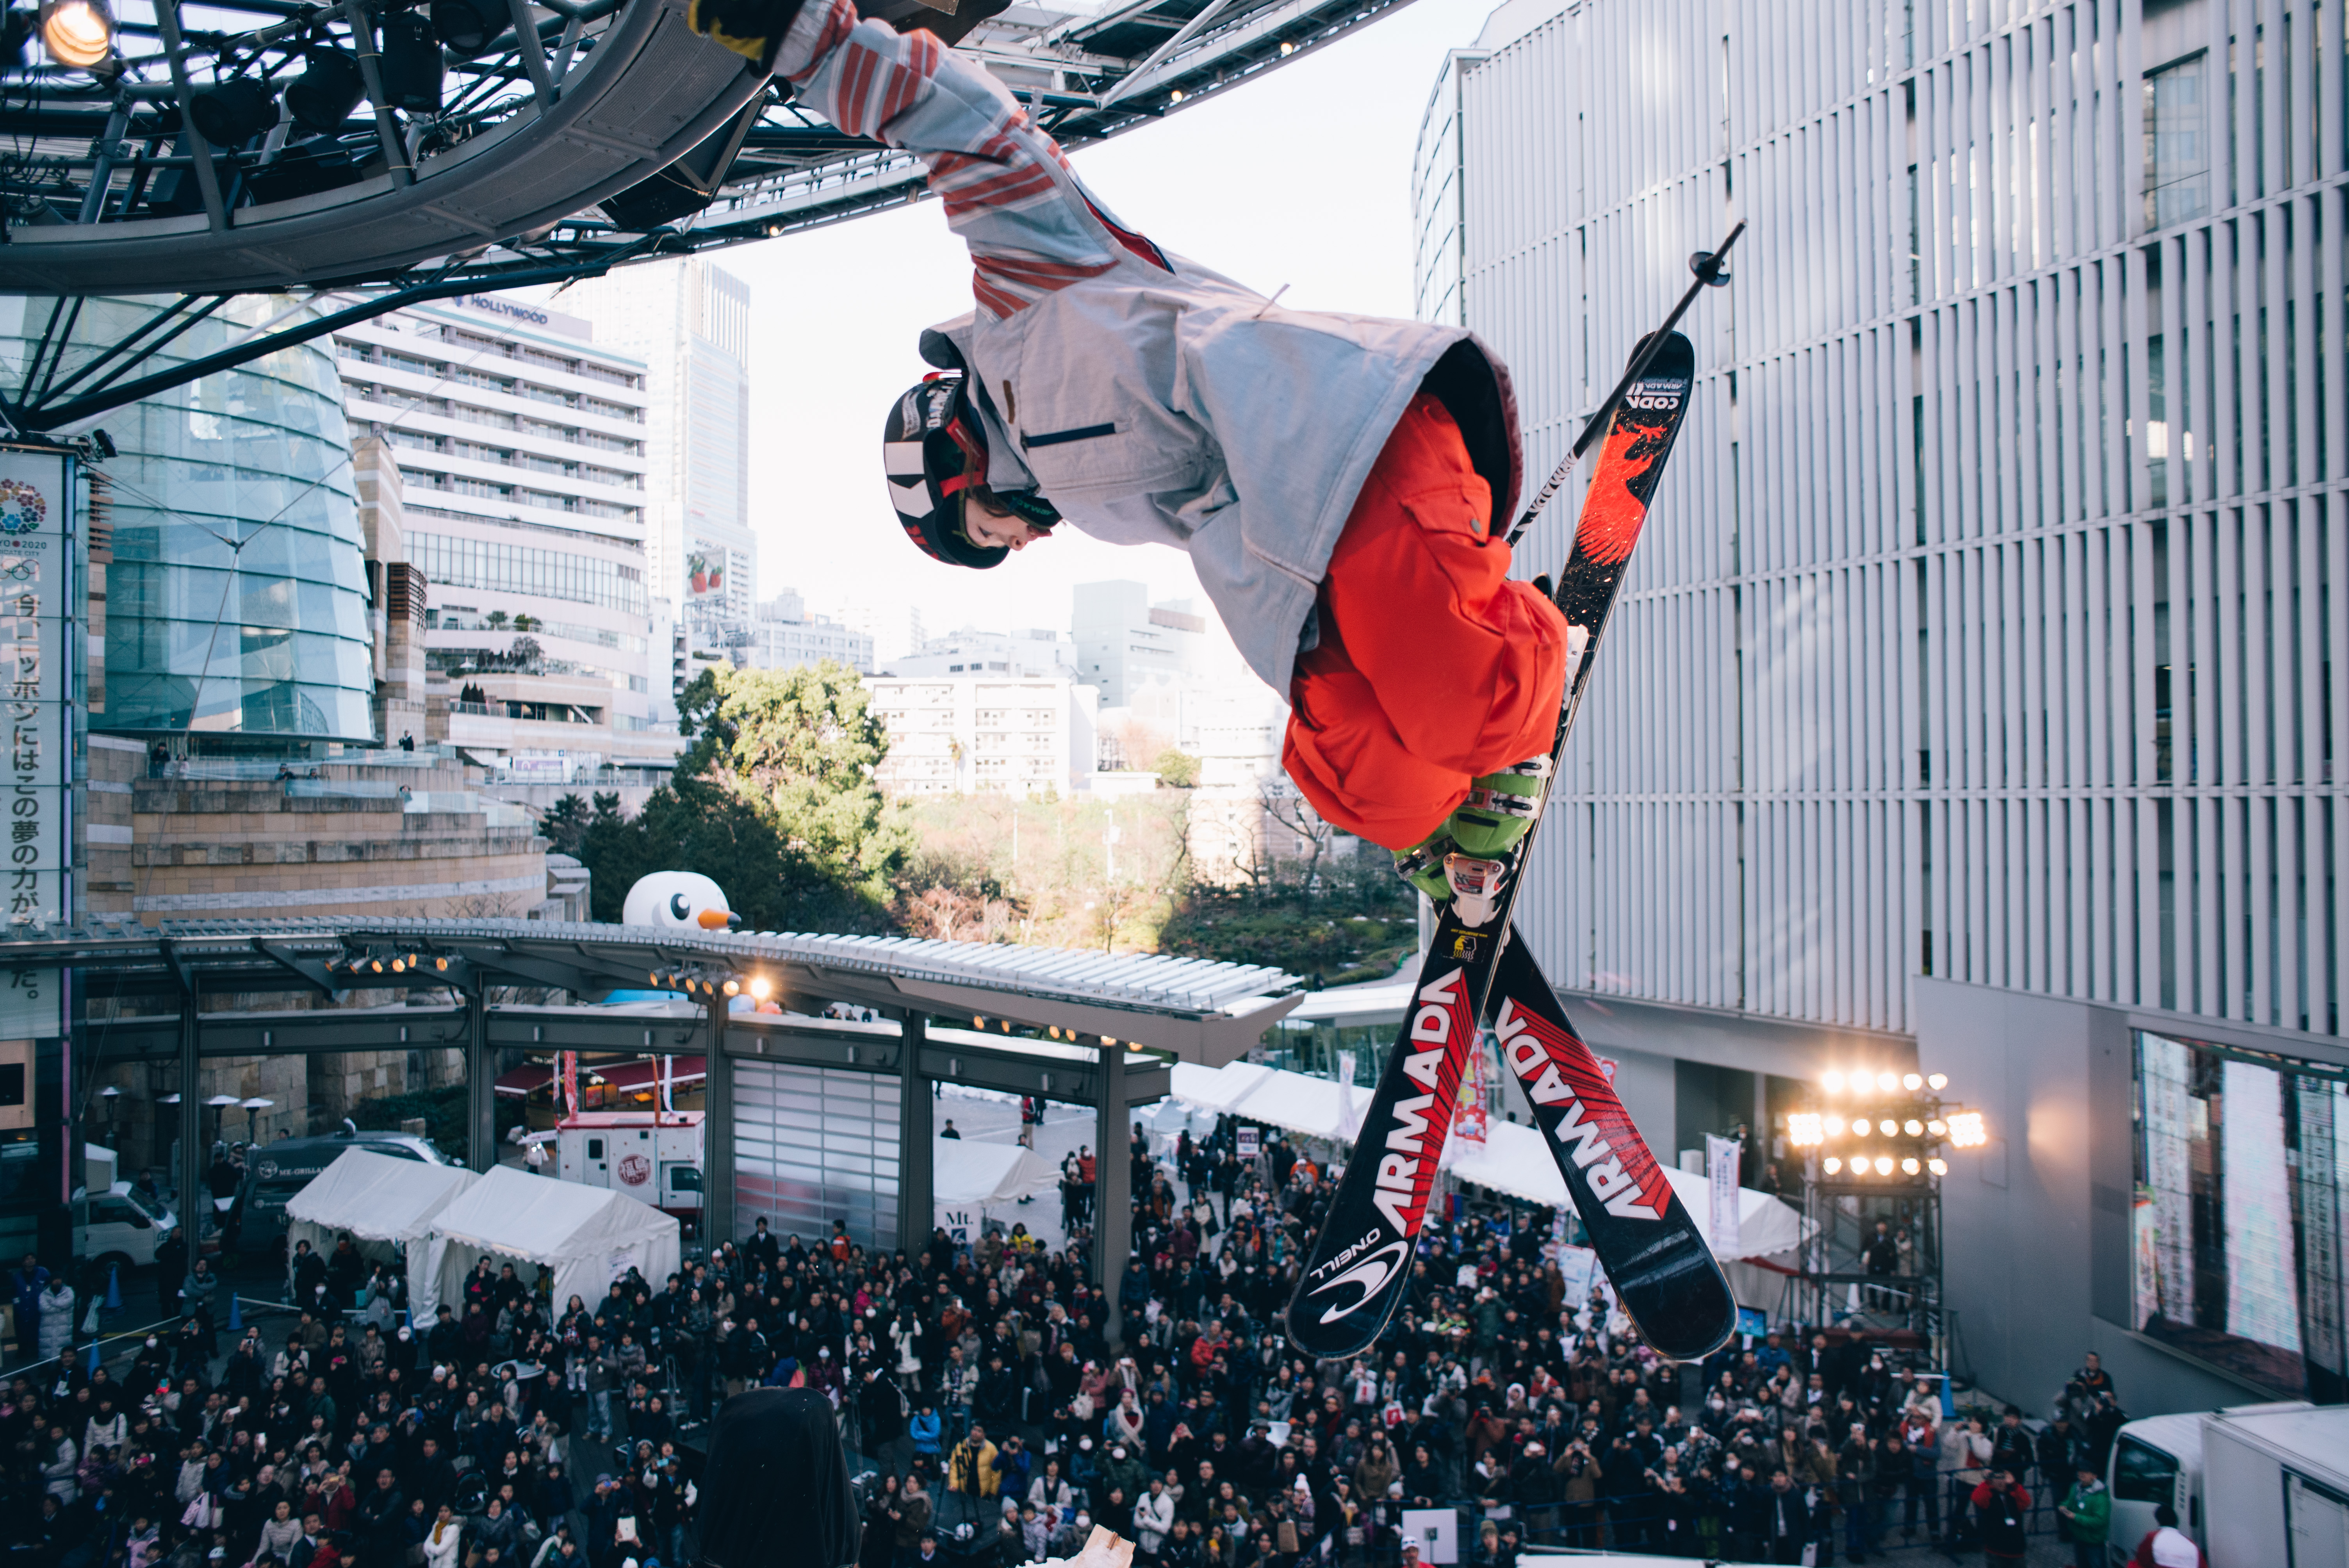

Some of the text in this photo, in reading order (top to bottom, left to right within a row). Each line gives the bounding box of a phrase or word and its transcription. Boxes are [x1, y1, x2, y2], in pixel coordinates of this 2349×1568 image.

[471, 295, 548, 324] HOLLYWOOD
[1625, 396, 1679, 410] CODA
[22, 540, 46, 549] 2020
[1372, 966, 1461, 1238] ARMADA
[1494, 995, 1662, 1220] ARMADA
[946, 1211, 973, 1226] Mt.
